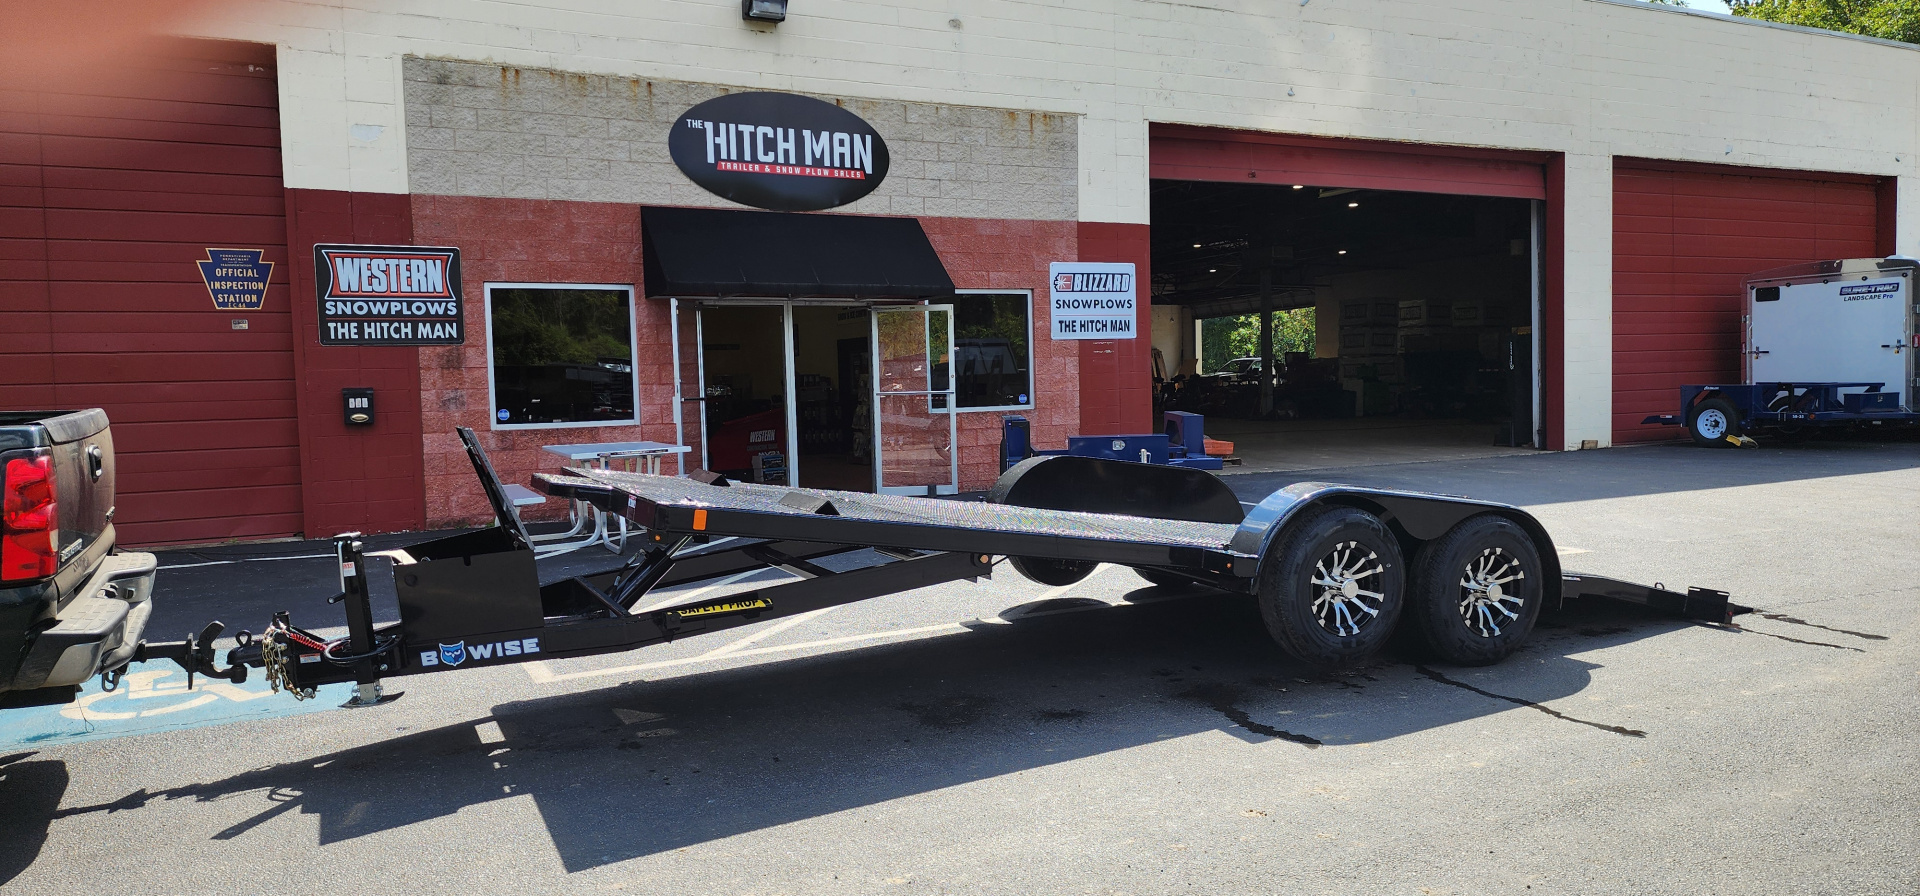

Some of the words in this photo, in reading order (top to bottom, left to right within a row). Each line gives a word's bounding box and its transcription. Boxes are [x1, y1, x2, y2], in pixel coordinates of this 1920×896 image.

[686, 119, 703, 129] THE
[704, 121, 796, 164] HITCH
[802, 129, 873, 174] MAN
[721, 162, 760, 171] TRAILER
[765, 165, 771, 173] &
[776, 166, 801, 174] SNOW
[806, 168, 830, 176] PLOW
[834, 170, 861, 178] SALES
[215, 268, 259, 277] OFFICIAL
[335, 257, 443, 293] WESTERN
[210, 281, 264, 290] INSPECTION
[1073, 273, 1130, 292] BLIZZARD
[217, 294, 258, 303] STATION
[1055, 299, 1133, 309] SNOWPLOWS
[325, 301, 457, 315] SNOWPLOWS
[328, 322, 358, 339] THE
[364, 322, 412, 339] HITCH
[418, 322, 457, 339] MAN
[1058, 320, 1077, 333] THE
[1080, 320, 1108, 333] HITCH
[1111, 320, 1130, 332] MAN
[750, 430, 776, 442] WESTERN
